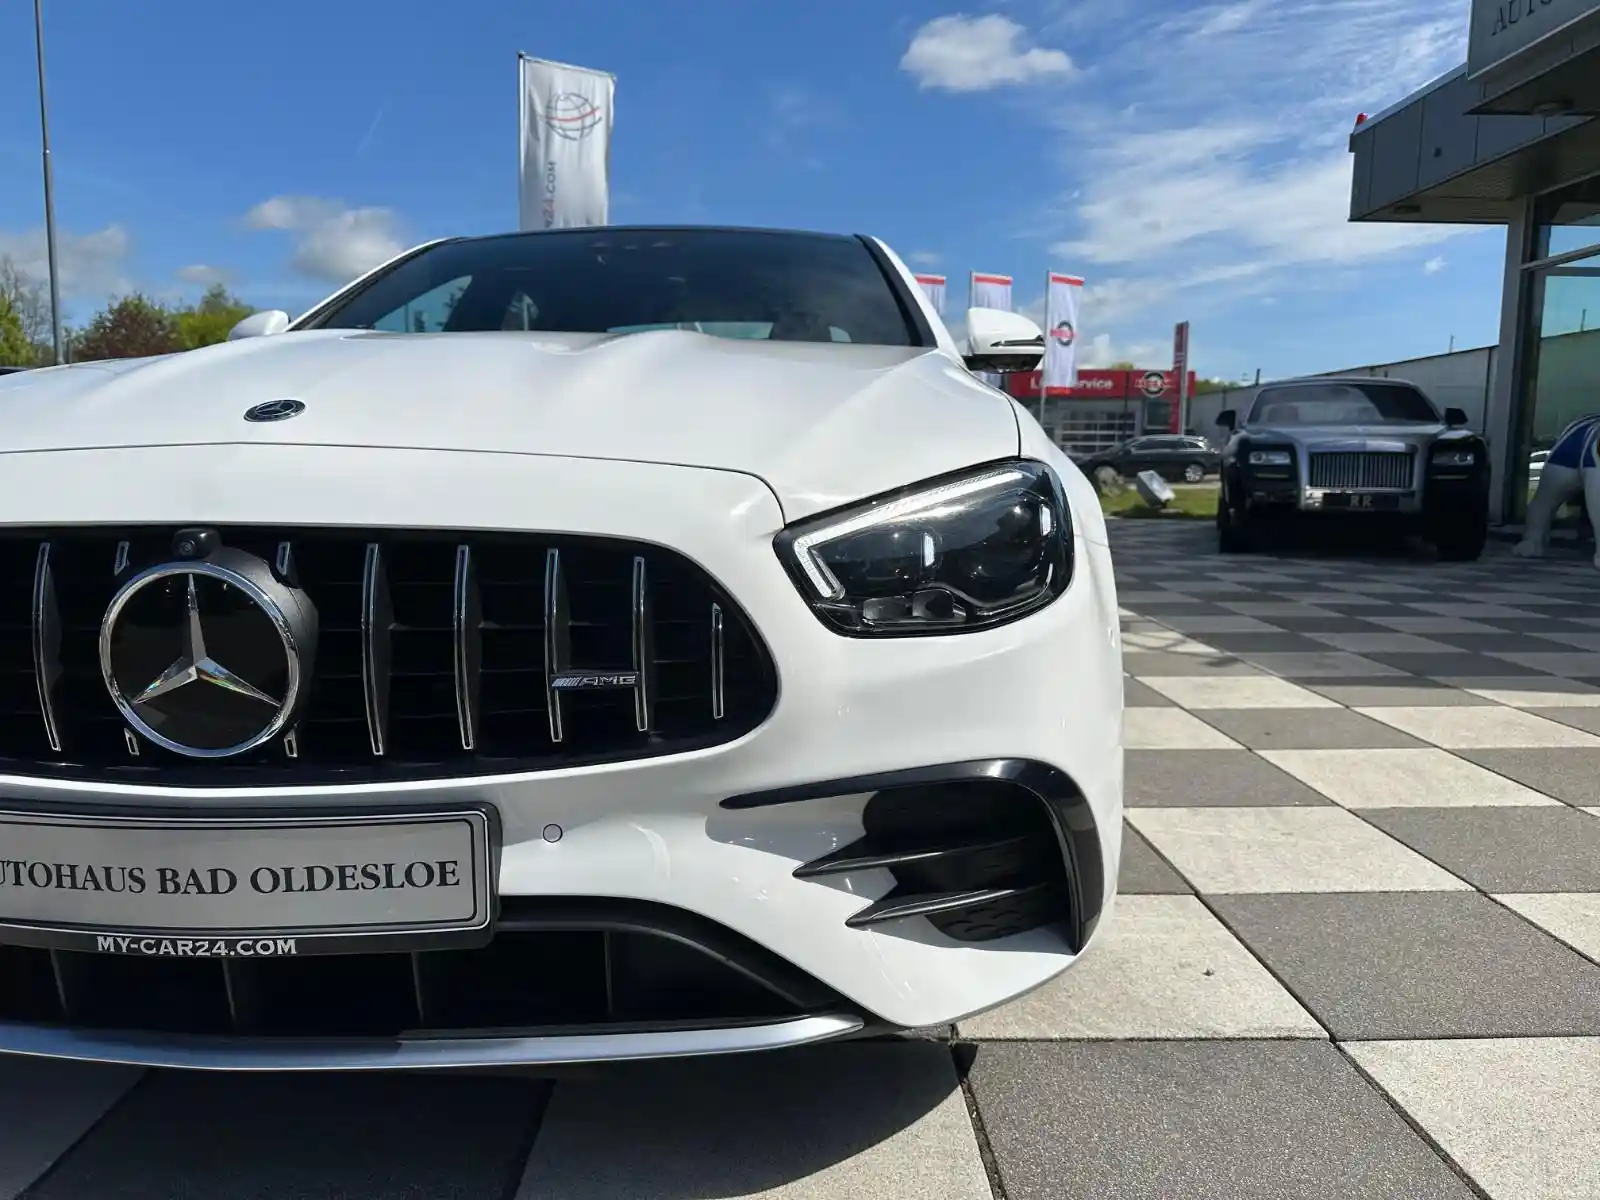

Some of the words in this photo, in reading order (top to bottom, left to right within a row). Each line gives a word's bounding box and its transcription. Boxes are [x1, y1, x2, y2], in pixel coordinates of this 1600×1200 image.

[580, 675, 636, 687] AMG
[157, 866, 238, 895] BAD
[250, 861, 461, 894] OLDESLOE
[96, 935, 297, 956] MY-CAR24.COM
